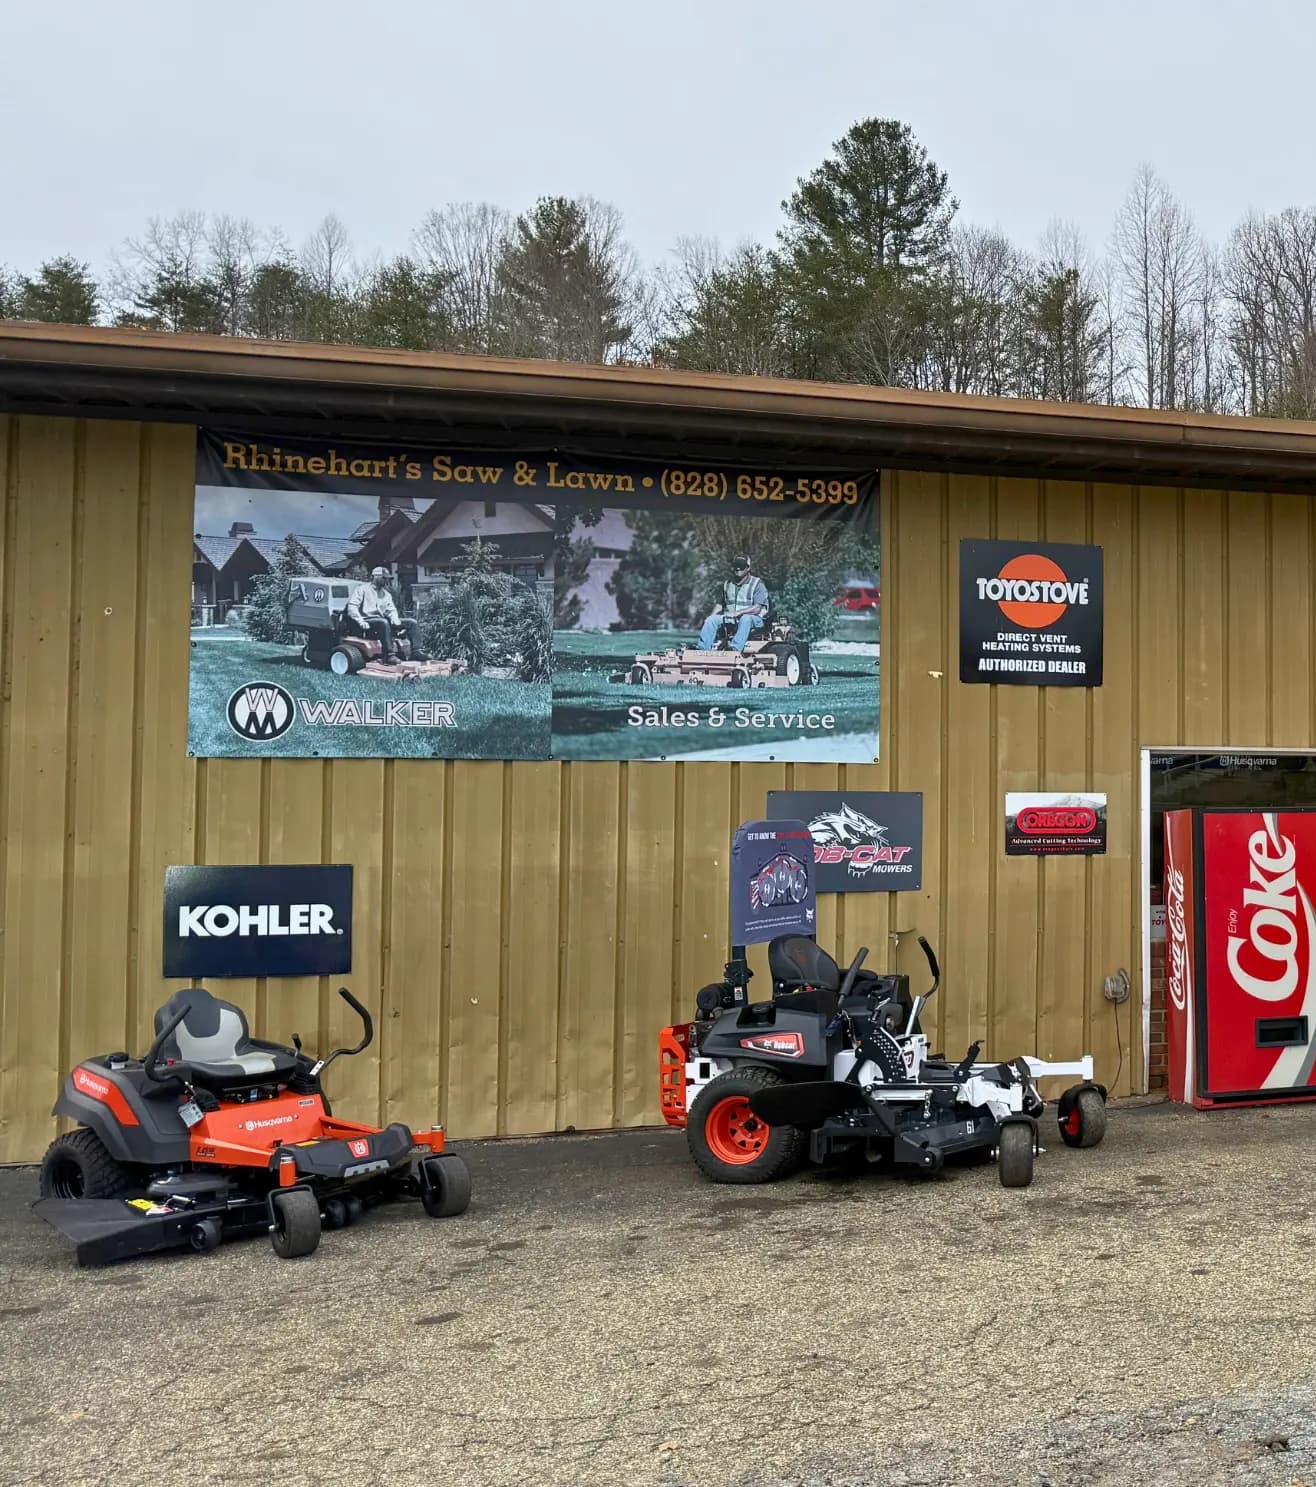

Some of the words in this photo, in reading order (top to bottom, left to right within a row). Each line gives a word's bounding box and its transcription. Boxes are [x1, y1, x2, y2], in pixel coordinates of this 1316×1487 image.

[223, 442, 422, 480] Rhinehart's
[432, 455, 504, 484] Saw
[513, 460, 537, 487] &
[546, 462, 635, 492] Lawn
[660, 468, 729, 501] (828)
[736, 475, 858, 505] 652-5399
[976, 577, 1089, 605] TOYOSTOVE
[982, 641, 1029, 651] HEATING
[1032, 643, 1082, 653] SYSTEMS
[997, 632, 1037, 642] DIRECT
[1039, 633, 1068, 643] VENT
[978, 658, 1046, 672] AUTHORIZED
[1048, 660, 1086, 674] DEALER
[298, 698, 458, 728] WALKER
[627, 705, 700, 727] Sales
[708, 706, 726, 727] &
[735, 707, 836, 729] Service
[1229, 755, 1277, 767] Husqvarna
[1025, 812, 1088, 827] OREGON
[872, 864, 913, 873] MOWERS
[178, 904, 338, 937] KOHLER
[1226, 830, 1299, 1002] Coke
[1227, 908, 1238, 934] Enjoy
[1168, 864, 1186, 1011] Coca-Cola
[254, 1115, 293, 1130] Husqvarna
